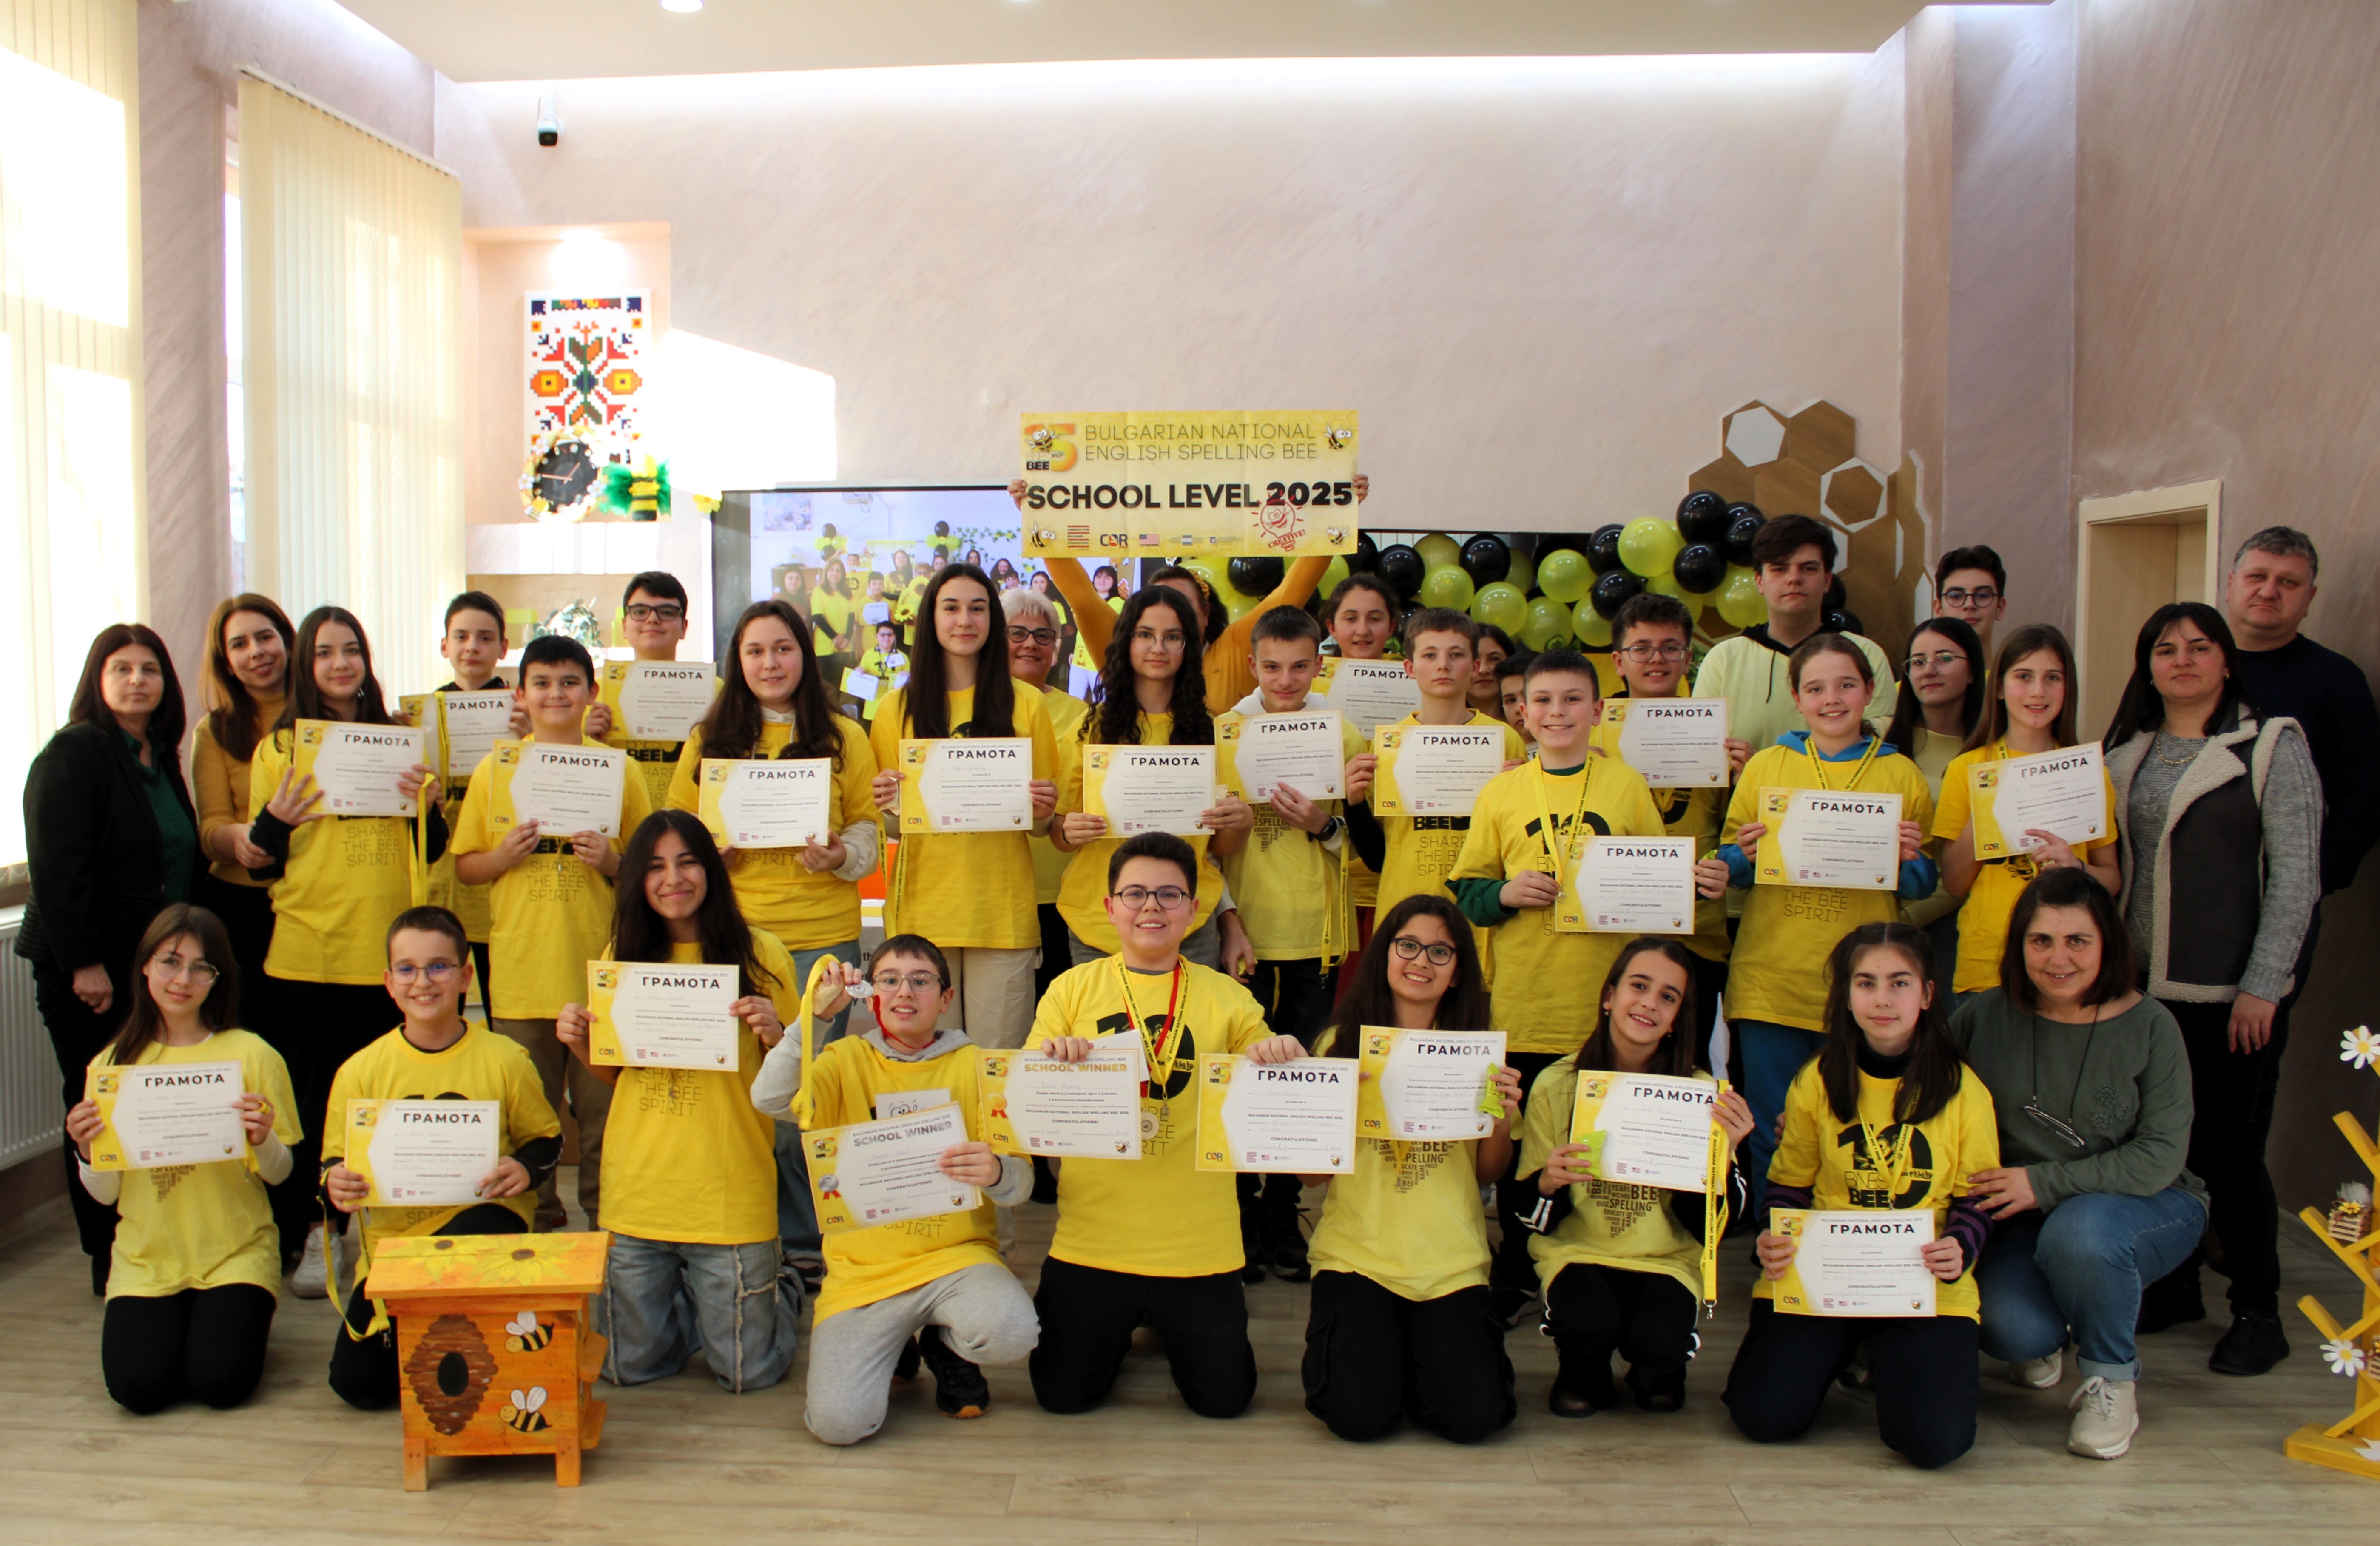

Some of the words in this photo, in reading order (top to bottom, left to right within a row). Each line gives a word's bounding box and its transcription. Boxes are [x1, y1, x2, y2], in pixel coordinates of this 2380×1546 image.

[1085, 425, 1203, 441] BULGARIAN
[1212, 423, 1316, 439] NATIONAL
[1085, 445, 1172, 460] ENGLISH
[1178, 444, 1274, 460] SPELLING
[1282, 443, 1317, 458] BEE
[1026, 461, 1049, 470] BEE
[1027, 484, 1161, 509] SCHOOL
[1169, 484, 1259, 508] LEVEL
[1266, 482, 1352, 505] 2025
[1268, 529, 1306, 548] CREATIVE!
[644, 670, 702, 679] ГРАМОТА
[445, 701, 504, 710] РАМОТА
[1647, 709, 1713, 718] ГРАМОТА
[1262, 722, 1327, 733] ГРАМОТА
[345, 734, 410, 747] ГРАМОТА
[1423, 736, 1490, 745] ГРАМОТА
[948, 750, 1016, 759] ГРАМОТА
[542, 754, 609, 768] ГРАМОТА
[1131, 757, 1200, 766] ГРАМОТА
[2021, 757, 2089, 778] ГРАМОТА
[749, 770, 815, 779] ГРАМОТА
[1811, 802, 1885, 814] ГРАМОТА
[1413, 816, 1451, 831] BEE
[347, 825, 394, 838] SHARE
[342, 839, 371, 852] THE
[378, 838, 399, 850] BEE
[743, 852, 799, 866] SPIRIT
[1414, 850, 1442, 862] THE
[1607, 848, 1679, 858] ГРАМОТА
[347, 853, 398, 867] SPIRIT
[526, 876, 551, 887] THE
[558, 876, 585, 888] BEE
[529, 890, 580, 902] SPIRIT
[1784, 889, 1812, 905] THE
[1818, 894, 1848, 909] BEE
[1784, 904, 1843, 923] SPIRIT
[642, 977, 720, 989] ГРАМОТА
[1418, 1044, 1491, 1055] ГРАМОТА
[1024, 1064, 1074, 1072] SCHOOL
[1077, 1064, 1127, 1072] WINNER
[145, 1074, 225, 1087] ГРАМОТА
[1258, 1070, 1339, 1083] ГРАМОТА
[637, 1080, 667, 1097] THE
[671, 1085, 702, 1101] BEE
[1634, 1087, 1715, 1105] ГРАМОТА
[639, 1097, 696, 1117] SPIRIT
[403, 1113, 481, 1123] ГРАМОТА
[854, 1132, 902, 1146] SCHOOL
[904, 1121, 952, 1137] WINNER
[1422, 1141, 1447, 1152] BEE
[1402, 1153, 1444, 1163] PELLING
[1643, 1151, 1690, 1160] CONGRATULATIONS!
[886, 1180, 933, 1191] CONGRATULATIONS!
[1845, 1171, 1889, 1189] BNES
[1631, 1184, 1657, 1201] BEE
[1850, 1188, 1889, 1208] BEE
[1609, 1198, 1652, 1212] SPELLING
[1604, 1209, 1624, 1217] EDUCATE
[1830, 1224, 1915, 1234] ГРАМОТА
